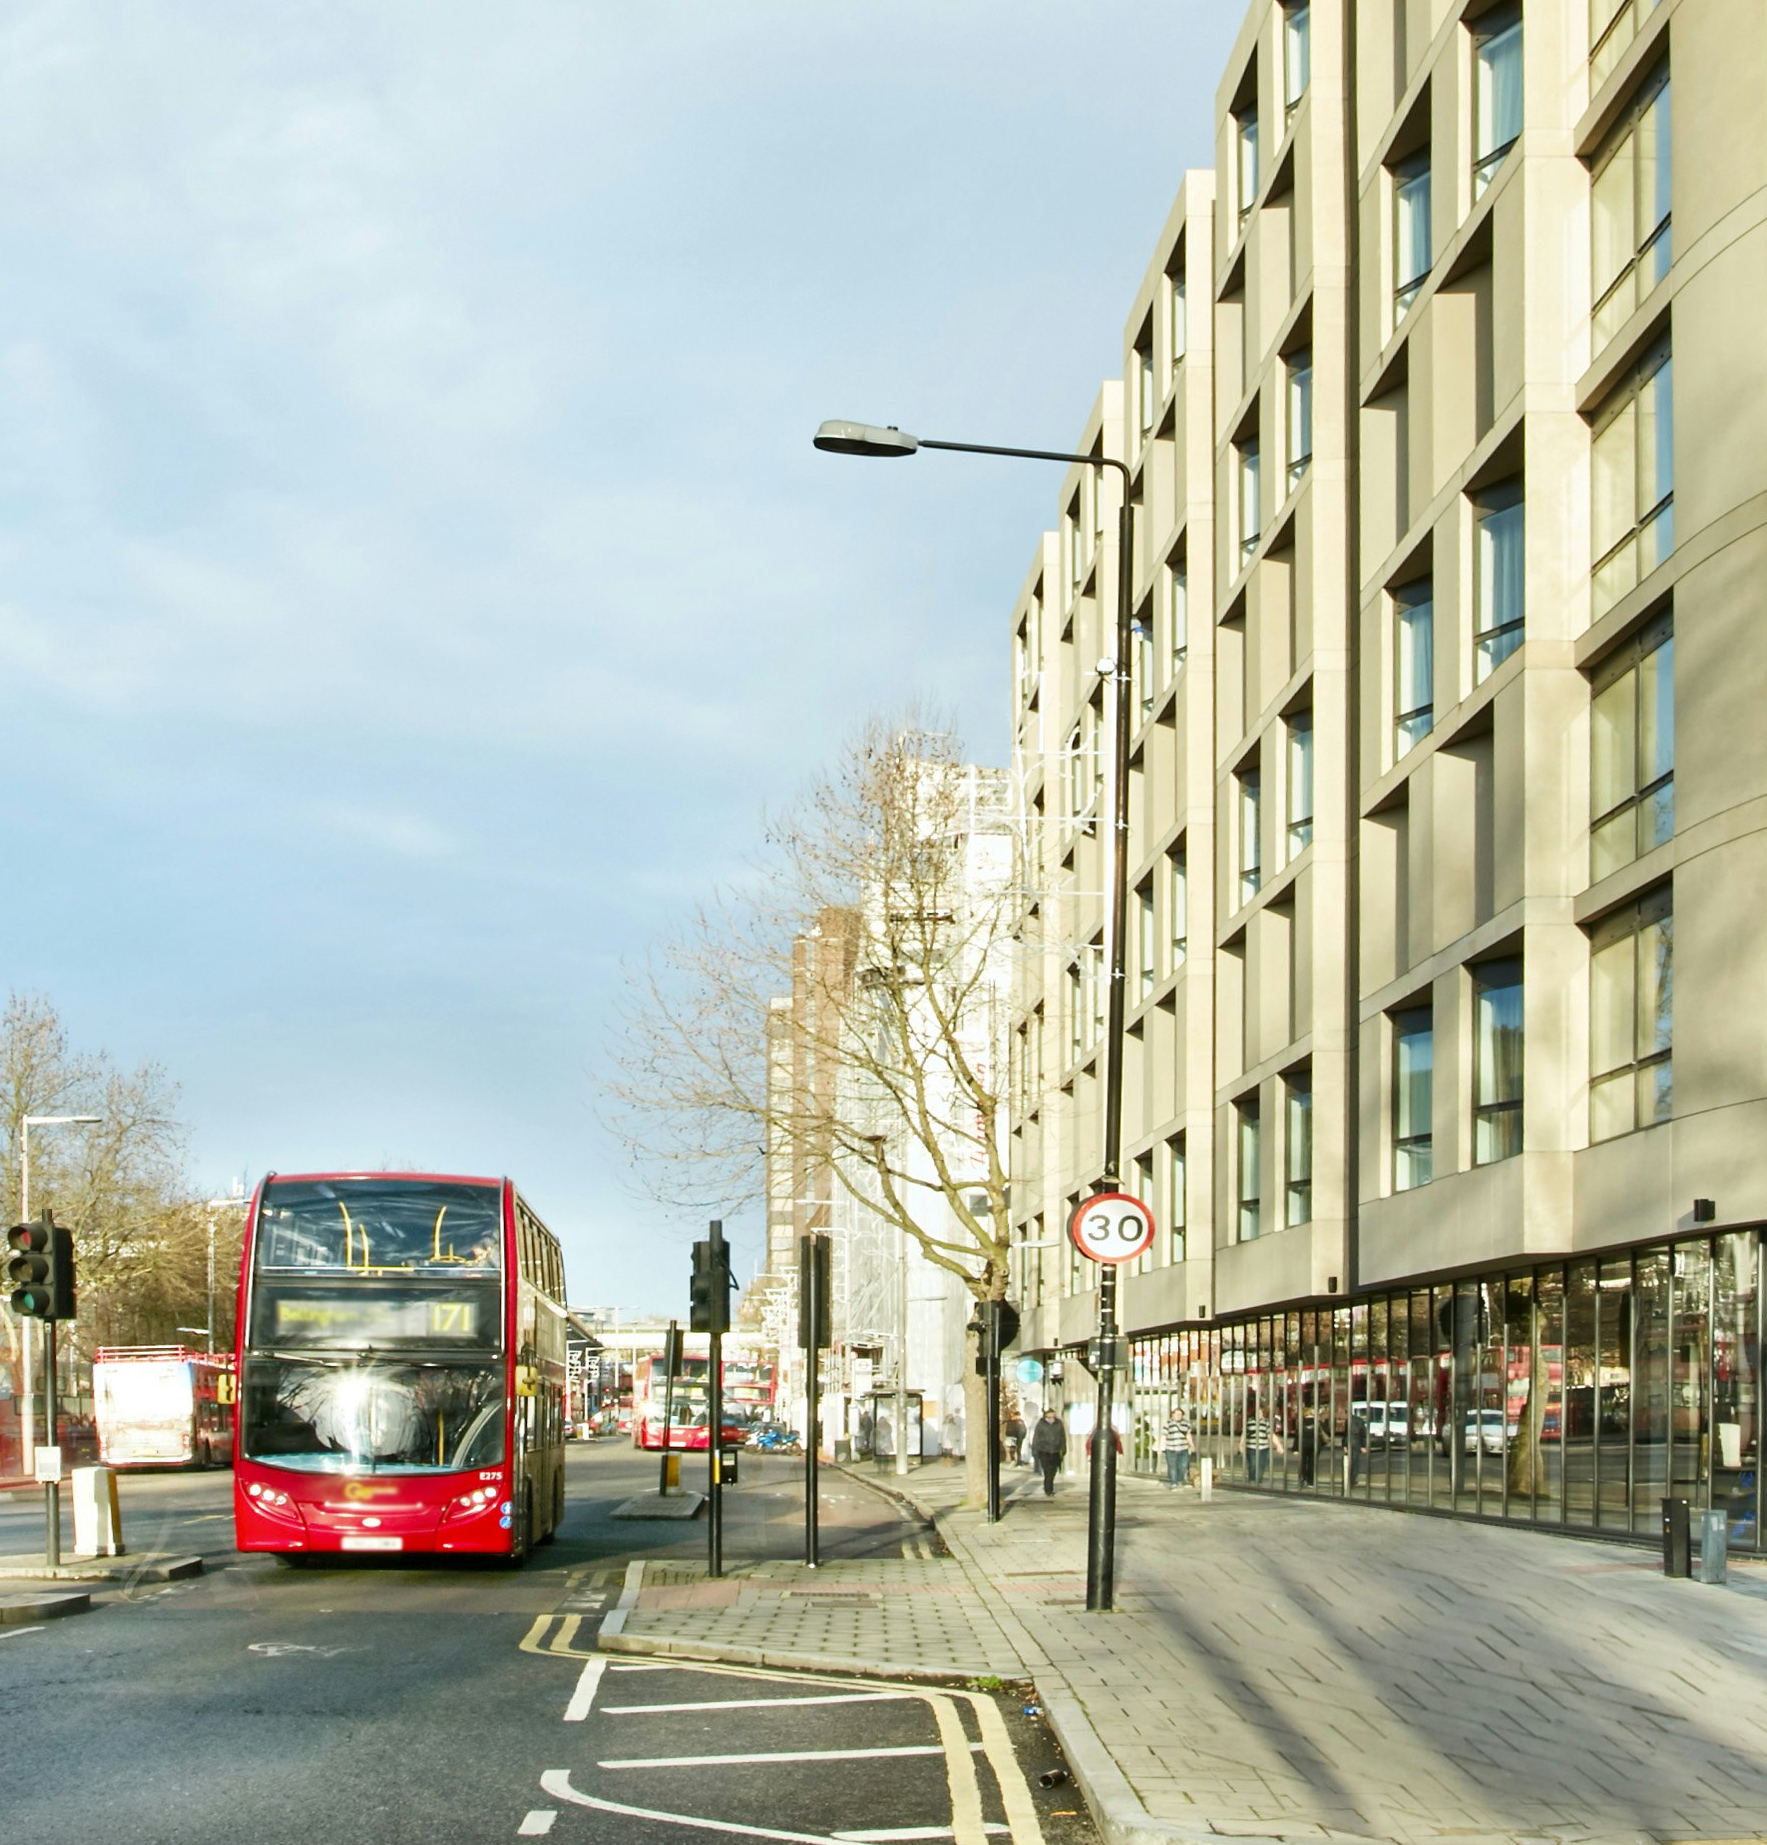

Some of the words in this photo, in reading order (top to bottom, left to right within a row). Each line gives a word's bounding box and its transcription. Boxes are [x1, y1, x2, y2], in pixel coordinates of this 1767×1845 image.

[1088, 1214, 1143, 1241] 30
[433, 1302, 470, 1331] 171
[479, 1472, 502, 1480] E275
